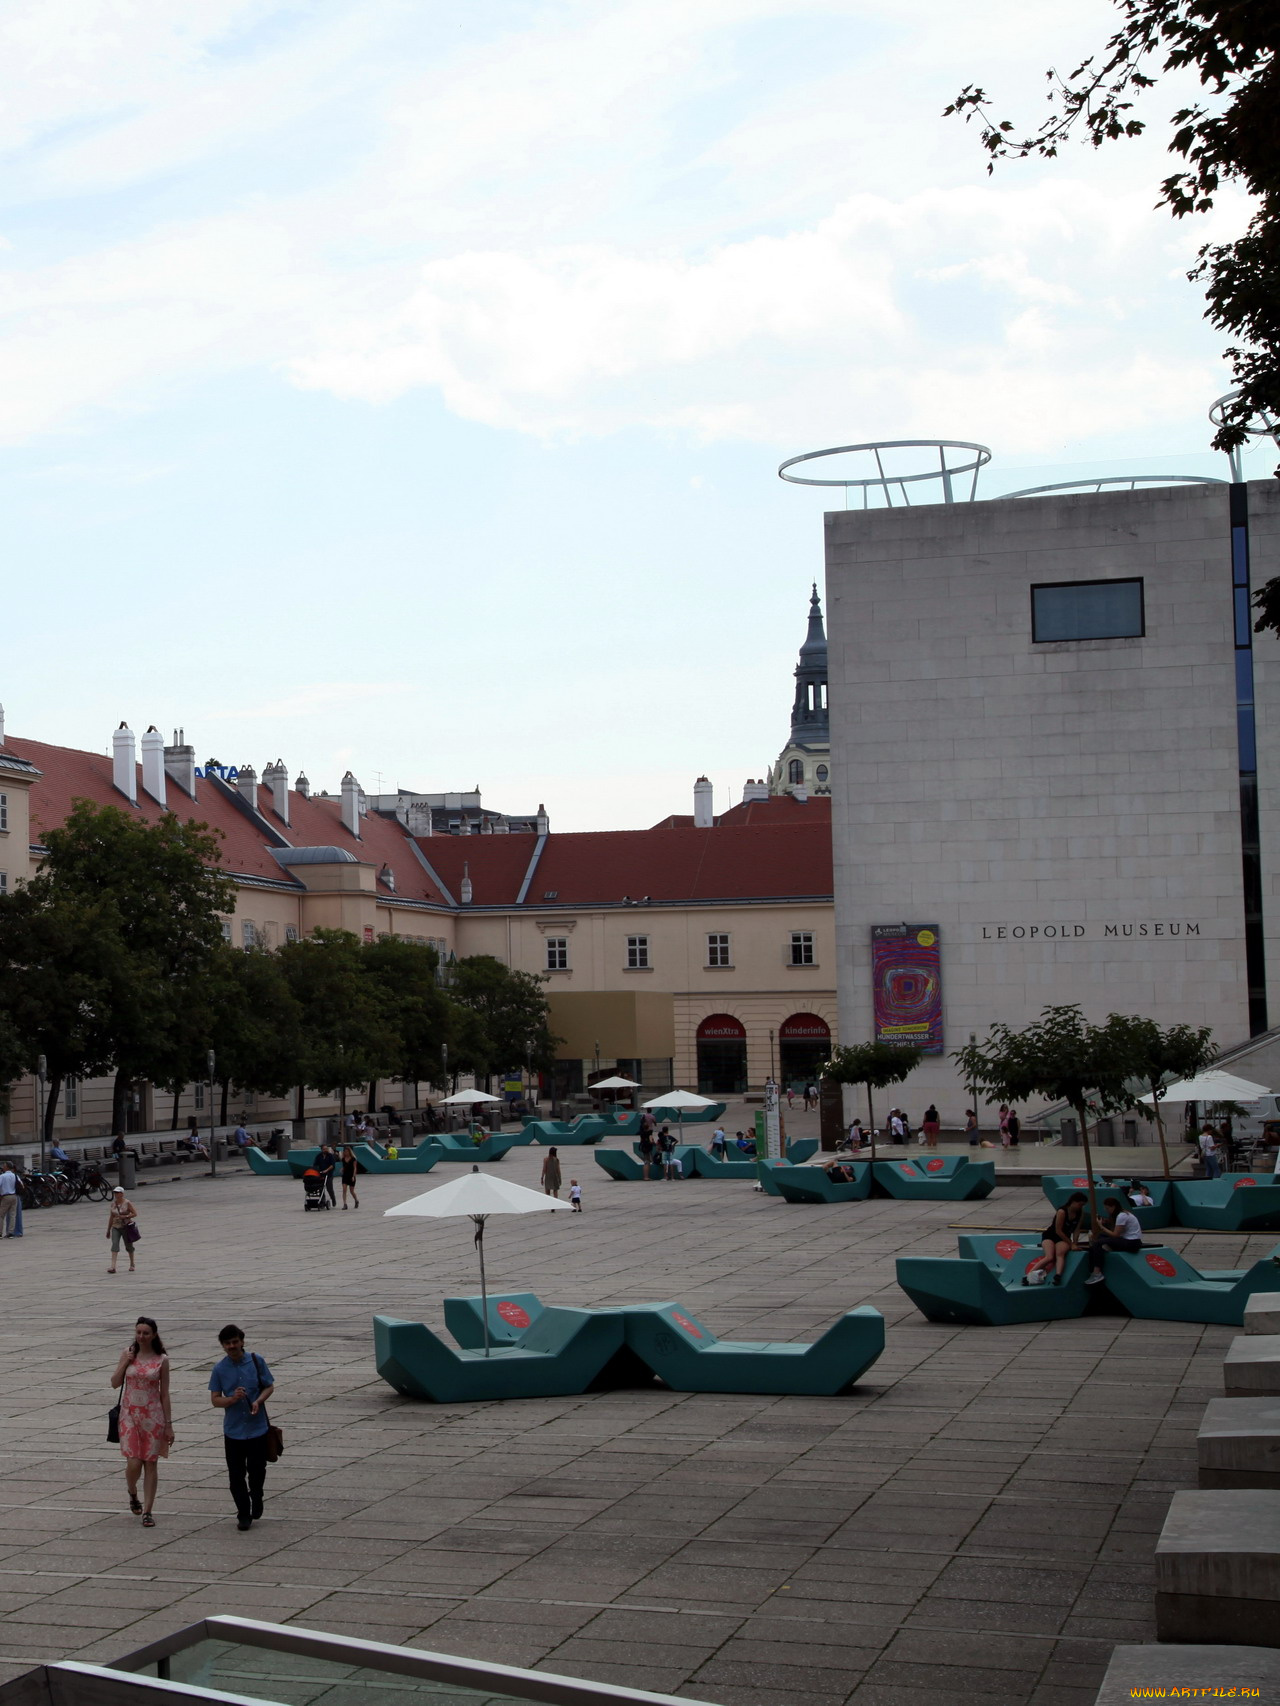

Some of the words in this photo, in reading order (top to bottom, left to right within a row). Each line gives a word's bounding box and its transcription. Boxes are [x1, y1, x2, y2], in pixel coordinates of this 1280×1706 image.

[982, 925, 1085, 939] LEOPOLD
[1104, 923, 1201, 937] MUSEUM
[704, 1027, 740, 1035] wienXtra
[785, 1026, 827, 1034] kinderinfo
